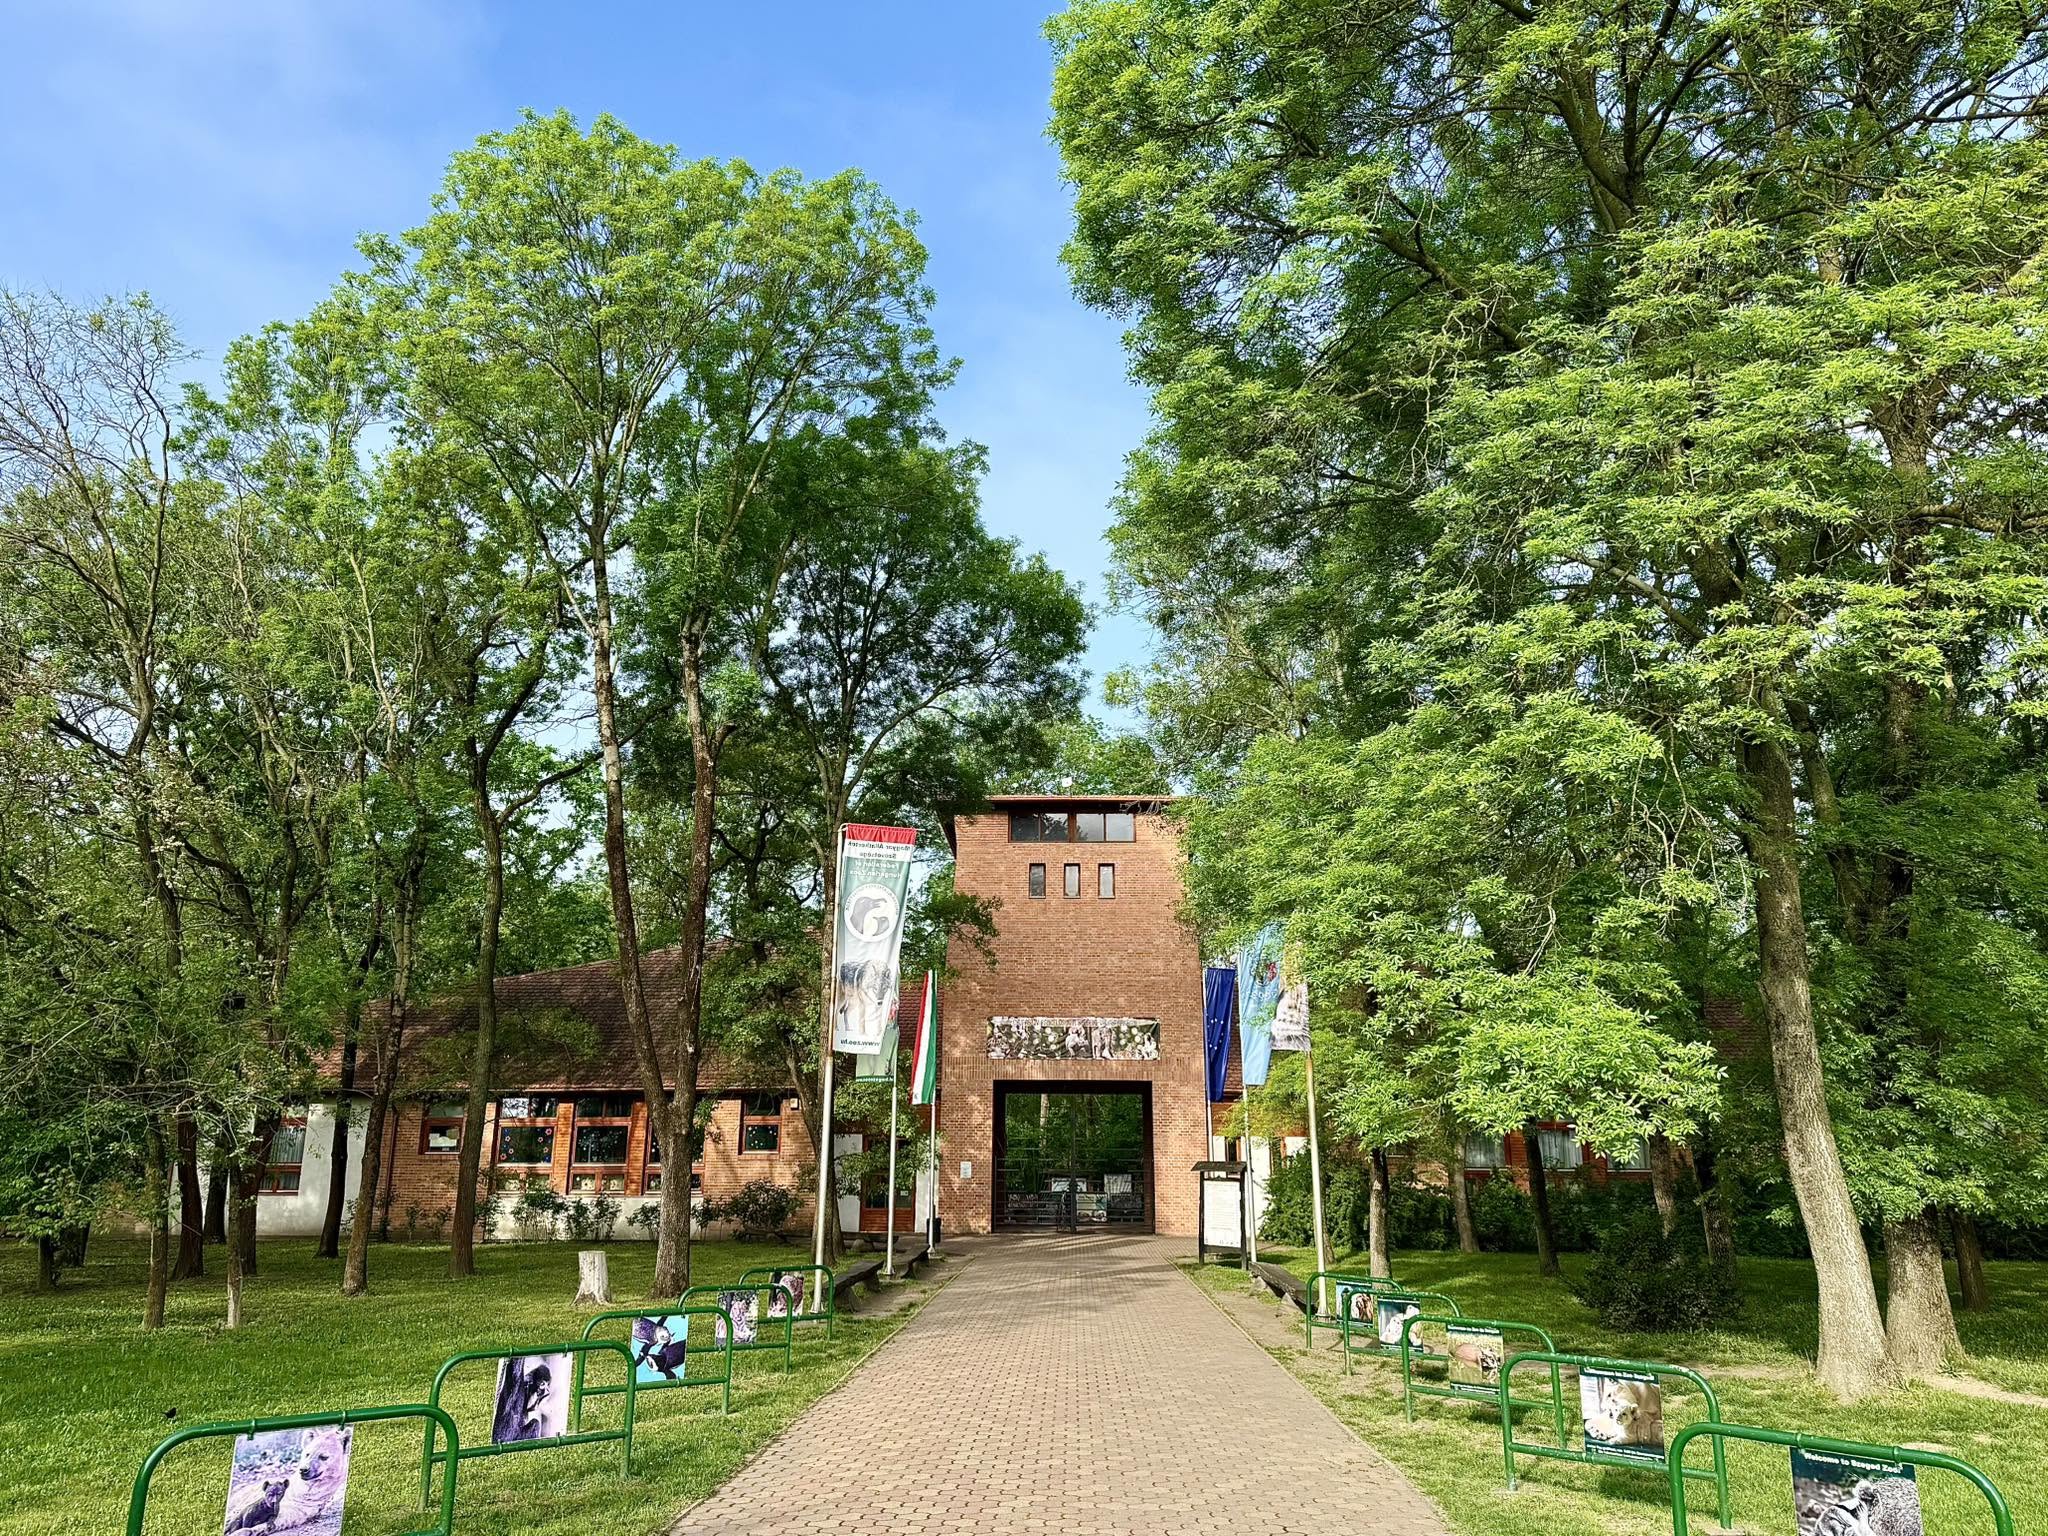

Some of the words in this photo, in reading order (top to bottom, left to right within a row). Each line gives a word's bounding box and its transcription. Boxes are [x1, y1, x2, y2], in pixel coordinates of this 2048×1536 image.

[1804, 1452, 1840, 1464] Welcome
[1840, 1458, 1850, 1466] to
[1850, 1459, 1881, 1471] Szeged
